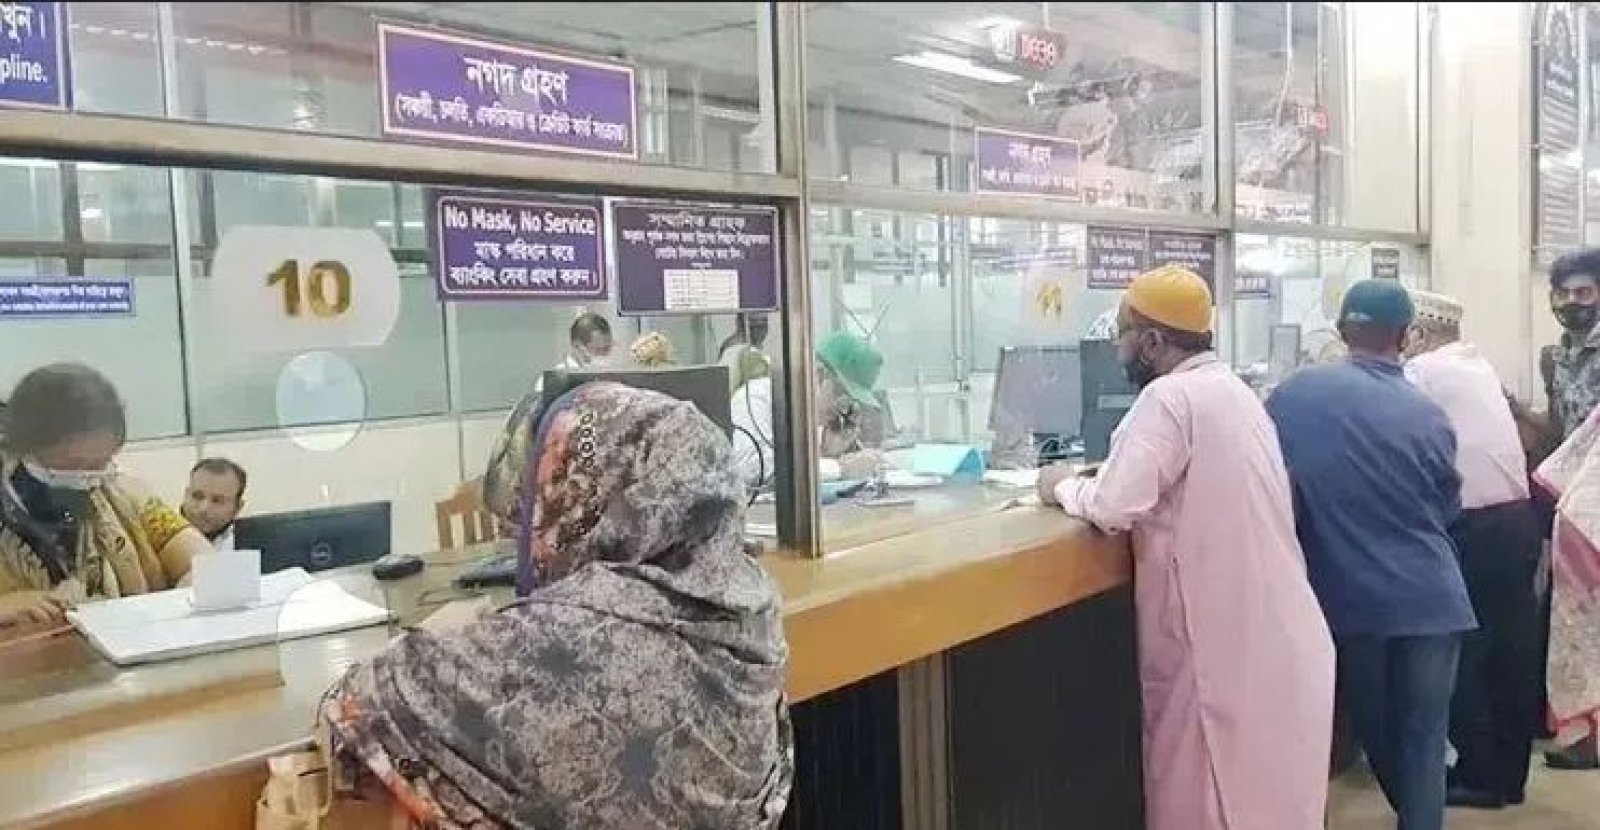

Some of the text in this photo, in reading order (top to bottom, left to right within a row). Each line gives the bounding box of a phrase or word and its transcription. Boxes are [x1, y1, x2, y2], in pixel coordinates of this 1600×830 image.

[463, 57, 569, 105] নগদ গ্রহণ
[445, 206, 596, 235] No Mask, No Service
[474, 237, 575, 262] মাস্ক পরিধান করে
[265, 258, 352, 318] 10
[500, 267, 528, 286] সেবা
